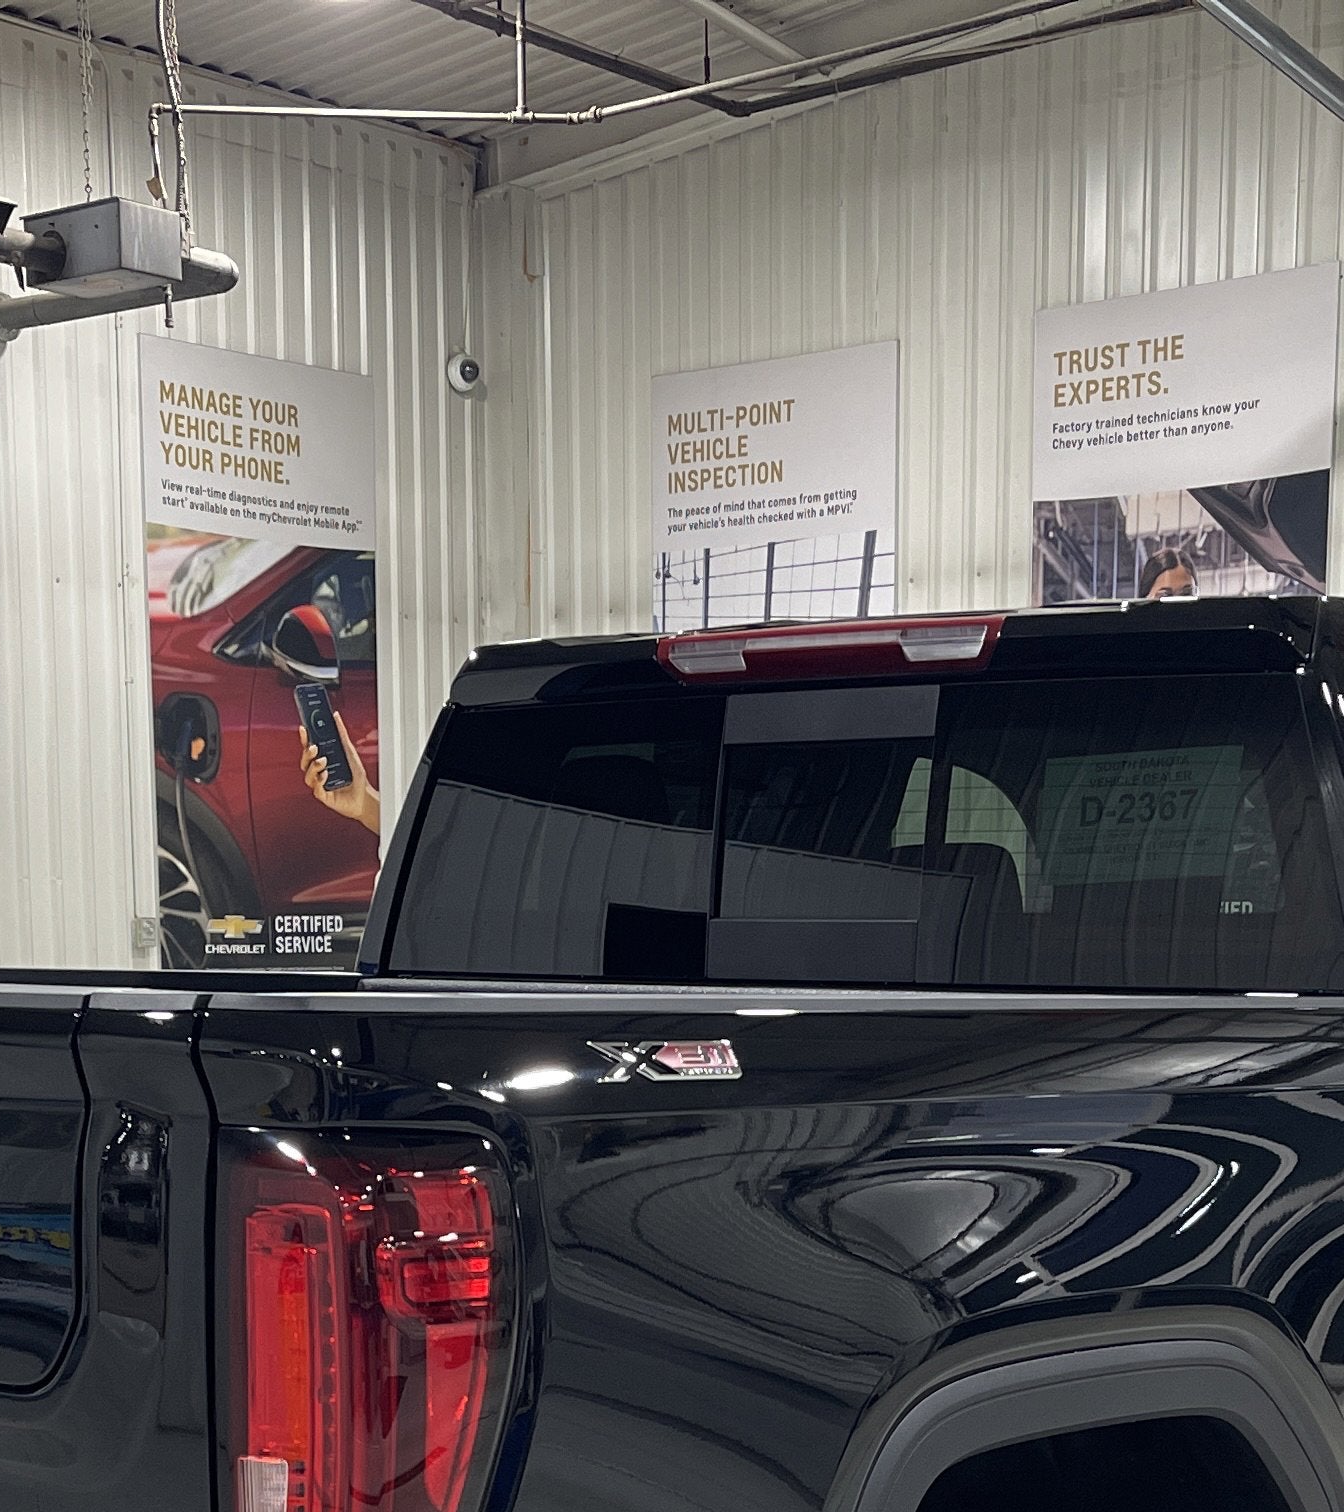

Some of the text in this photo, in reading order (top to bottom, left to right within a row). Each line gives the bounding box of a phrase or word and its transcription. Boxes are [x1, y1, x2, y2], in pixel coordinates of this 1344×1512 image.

[1053, 334, 1185, 376] TRUST THE
[160, 380, 298, 428] MANAGE YOUR
[1053, 370, 1169, 408] EXPERTS.
[667, 399, 795, 437] MULTI-POINT
[1052, 399, 1260, 434] Factory trained technicians know your
[160, 410, 301, 457] VEHICLE FROM
[667, 435, 749, 465] VEHICLE
[1052, 420, 1234, 451] Chevy vehicle better than anyone.
[160, 440, 290, 485] YOUR PHONE.
[668, 459, 784, 495] INSPECTION
[161, 478, 350, 517] View real-time diagnostics and enjoy remote
[668, 488, 857, 519] The peace of mind that comes from getting
[189, 500, 227, 516] available
[230, 507, 241, 517] on
[243, 507, 257, 520] the
[259, 510, 311, 528] myChevrolet
[314, 516, 339, 530] Mobile
[668, 522, 686, 536] your
[688, 515, 726, 531] vehicle's
[727, 514, 756, 527] health
[757, 510, 794, 524] checked
[796, 505, 816, 519] with
[819, 509, 824, 517] a
[1089, 770, 1192, 788] VEHICLE DEALER
[1095, 760, 1136, 773] SOUTH
[1080, 788, 1198, 828] D-2367
[274, 915, 343, 934] CERTIFIED
[205, 944, 266, 955] CHEVROLET
[275, 935, 333, 954] SERVICE
